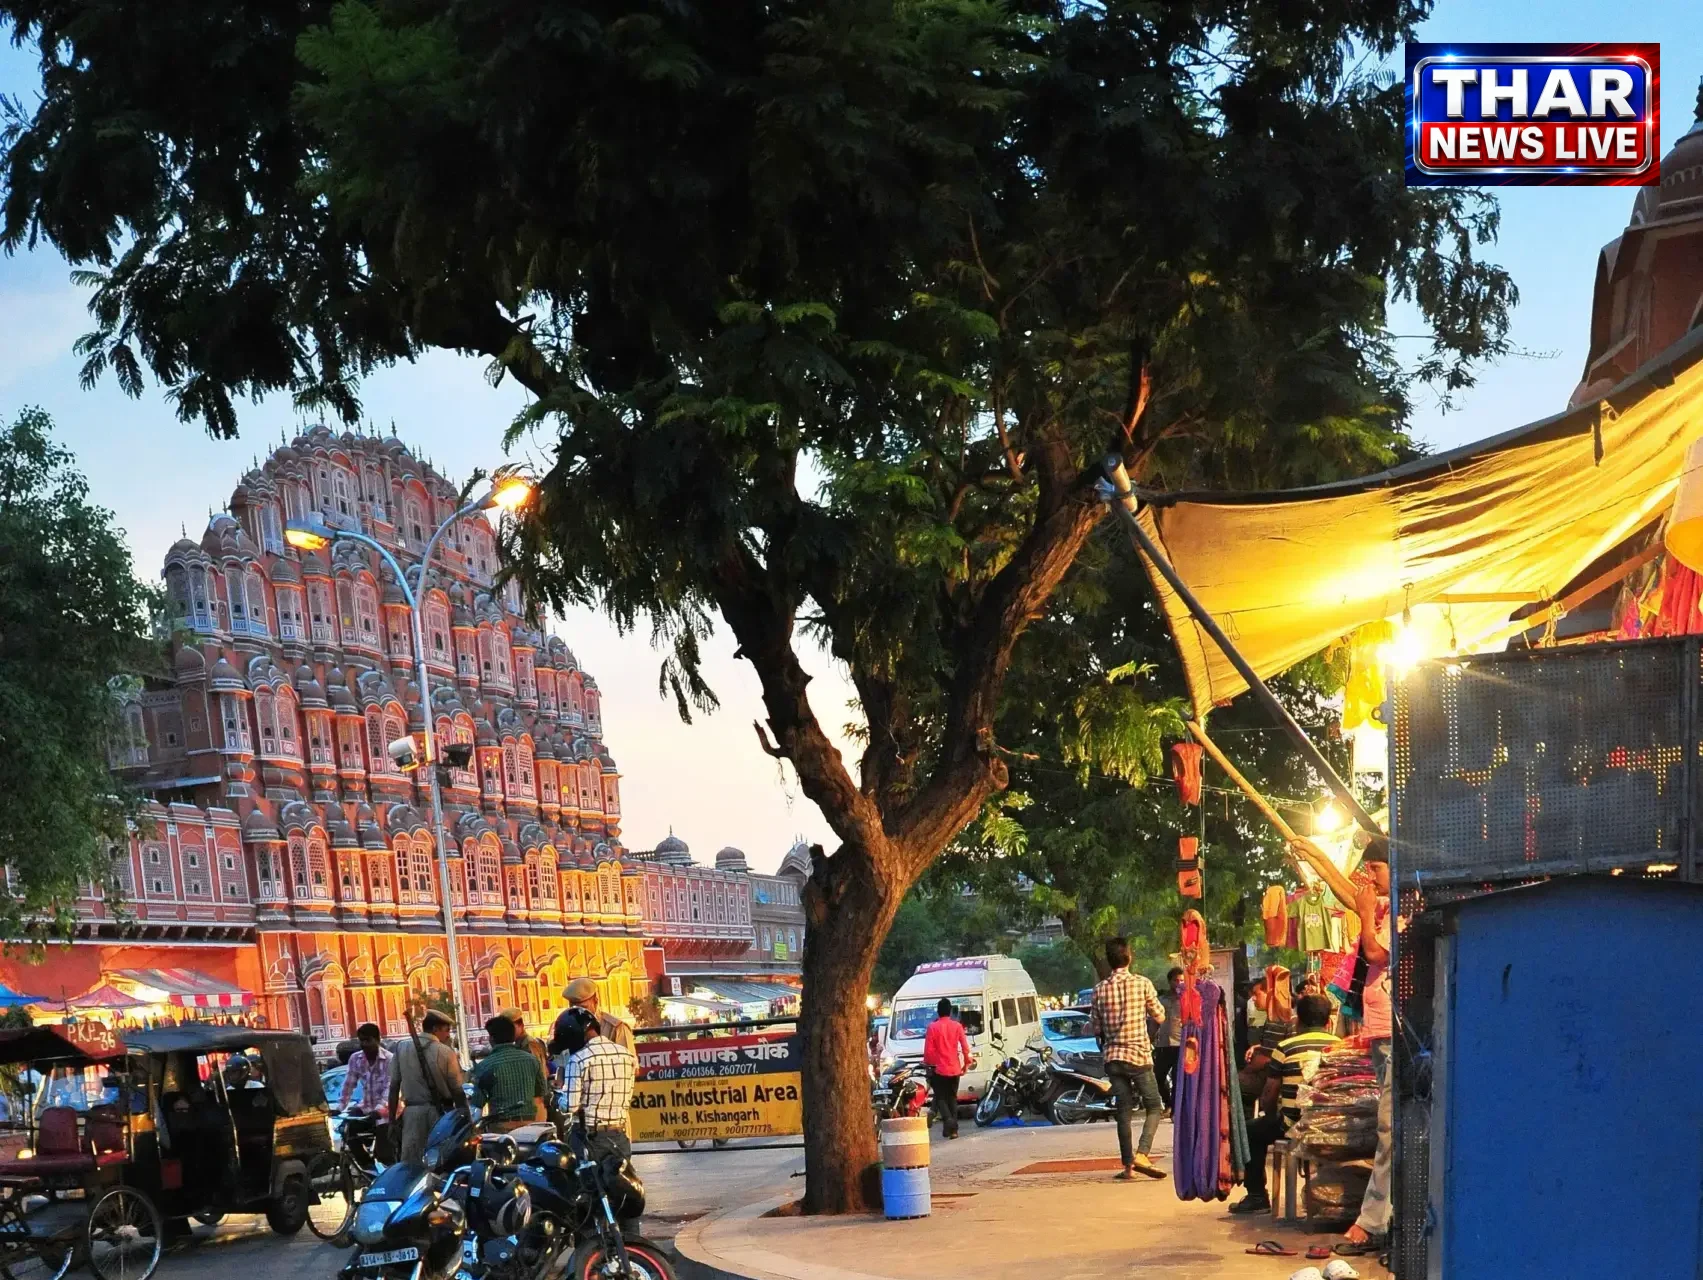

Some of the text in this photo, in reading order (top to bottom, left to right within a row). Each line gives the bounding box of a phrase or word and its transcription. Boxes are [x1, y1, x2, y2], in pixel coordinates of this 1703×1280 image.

[676, 1046, 739, 1065] माणक
[743, 1037, 790, 1060] चौक
[671, 1086, 747, 1107] Industrial
[753, 1084, 798, 1103] Area
[695, 1108, 760, 1126] Kishangarh
